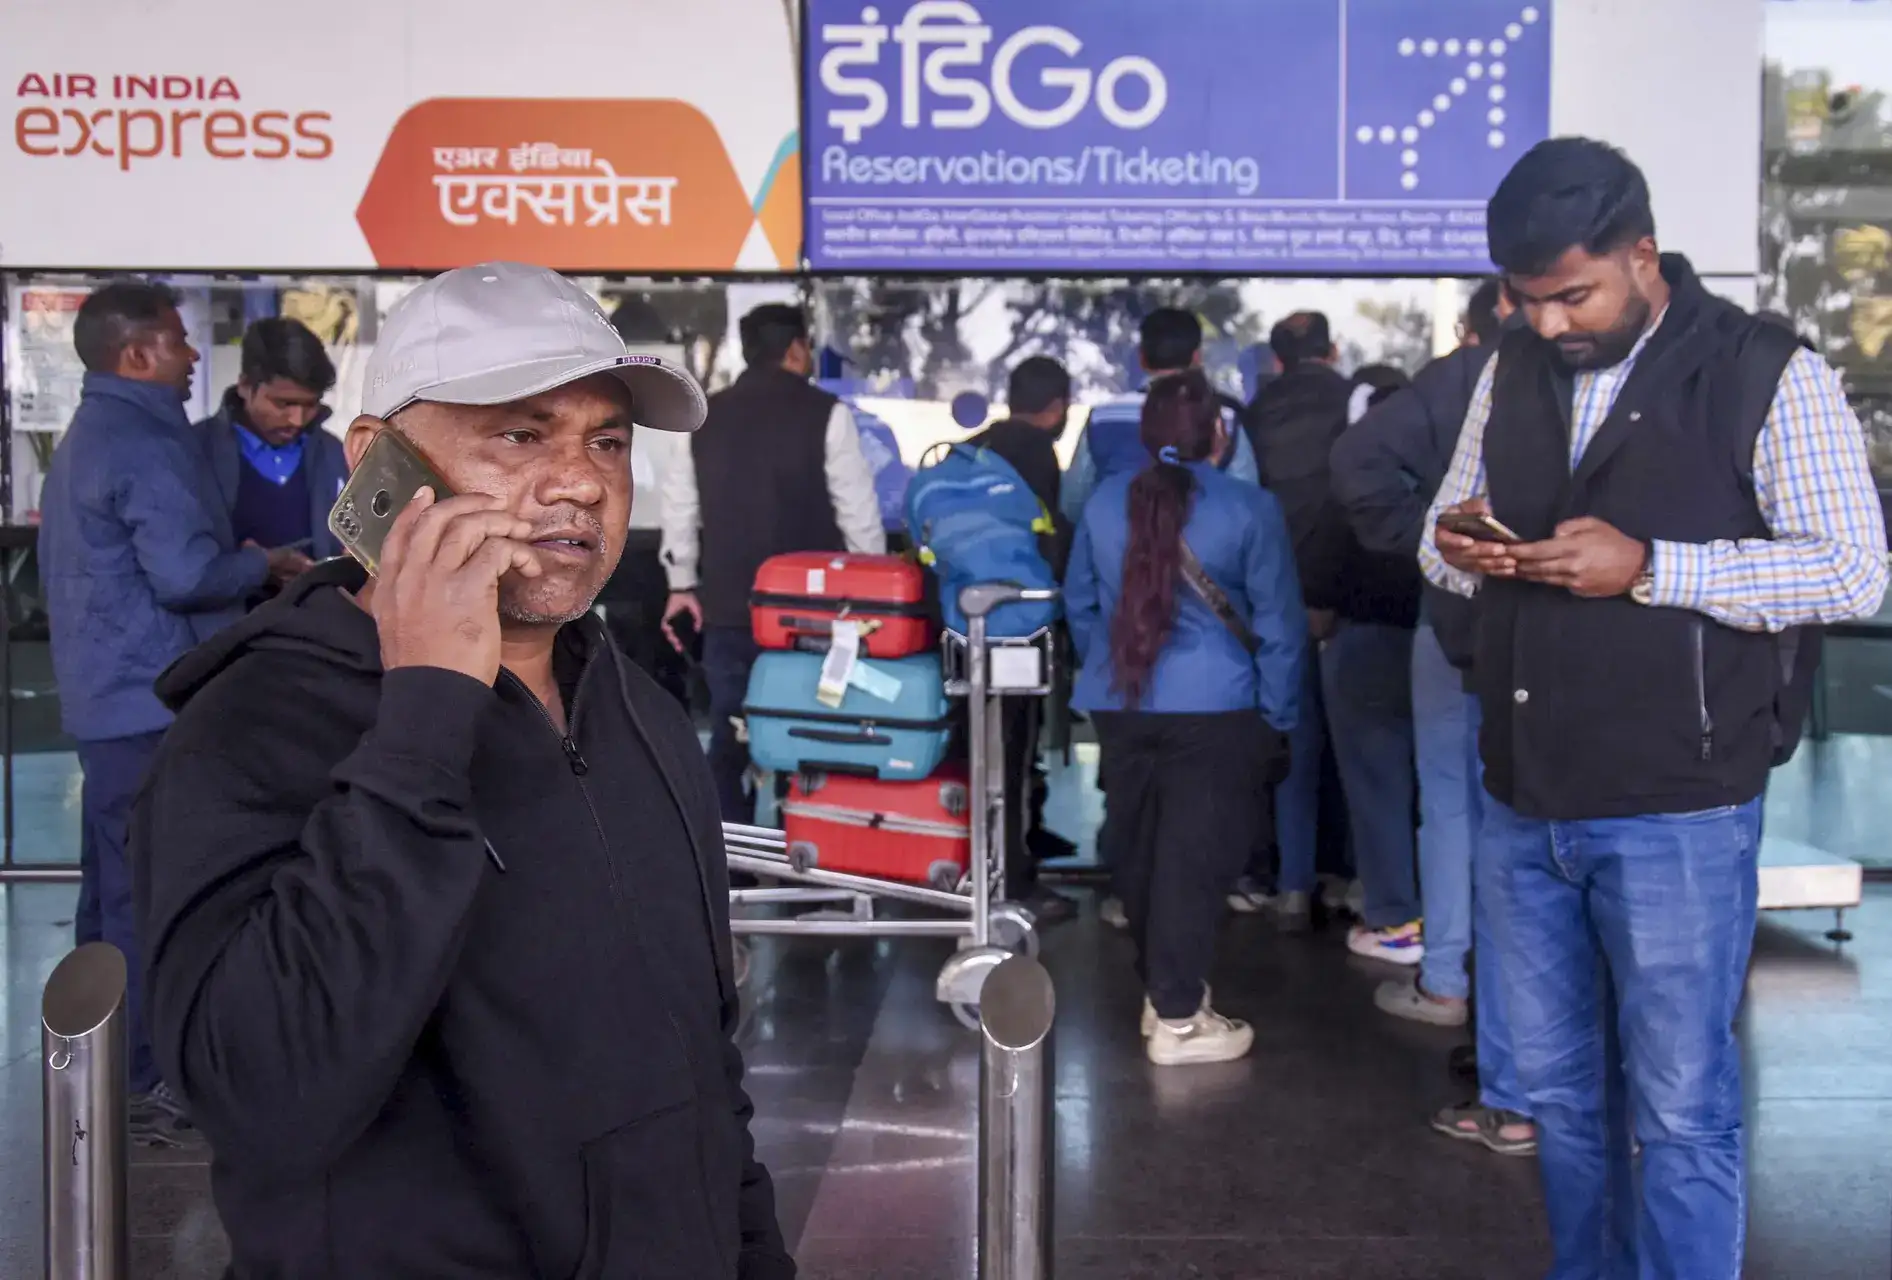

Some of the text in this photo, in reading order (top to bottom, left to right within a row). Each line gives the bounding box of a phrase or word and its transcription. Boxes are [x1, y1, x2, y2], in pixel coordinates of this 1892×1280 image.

[16, 72, 241, 100] AIR INDIA
[14, 106, 334, 171] express
[433, 142, 593, 172] एअर इंडिया
[432, 158, 679, 226] एक्सप्रेस
[822, 145, 1259, 195] Reservations/Ticketing
